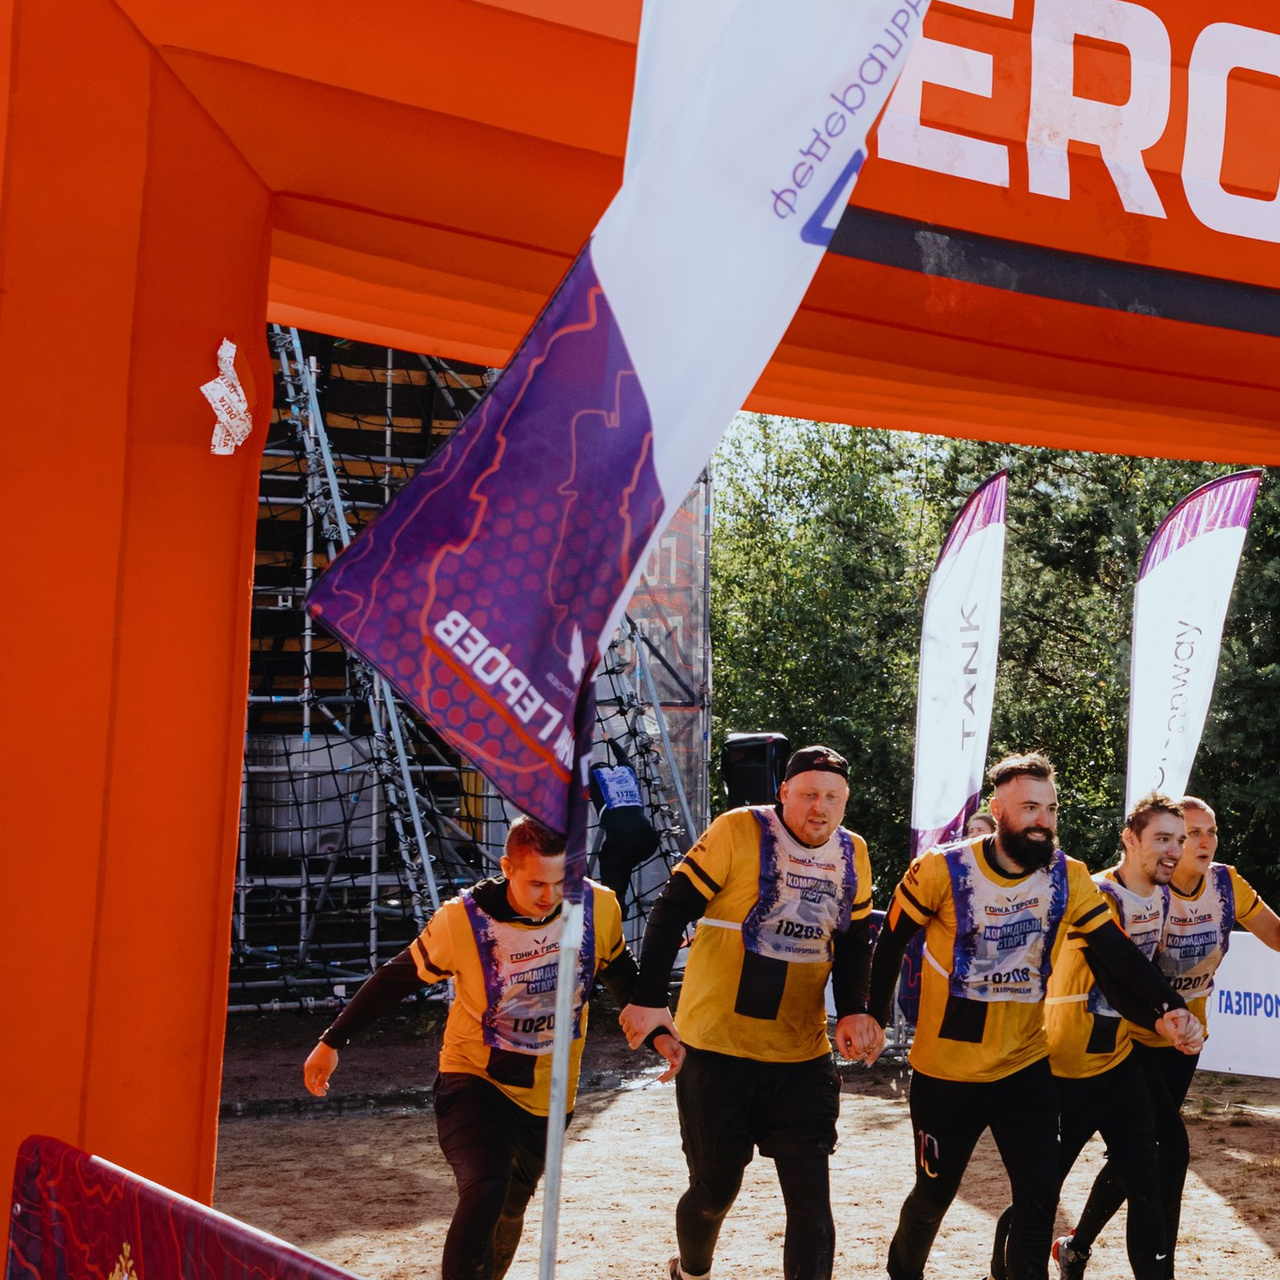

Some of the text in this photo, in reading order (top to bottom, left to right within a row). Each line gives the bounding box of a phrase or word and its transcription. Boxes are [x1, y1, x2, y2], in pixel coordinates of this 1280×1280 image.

[960, 602, 982, 751] TANK
[1012, 898, 1039, 911] ГЕРОЕВ
[997, 935, 1025, 949] СТАРТ
[1167, 931, 1217, 947] КОМАНДНЫЙ
[510, 949, 539, 961] ГОНКА
[1180, 946, 1205, 958] СТАРТ
[511, 965, 558, 986] КОМАНДН
[992, 986, 1032, 994] ГАЗПРОМБАНК
[512, 1013, 556, 1034] 1020
